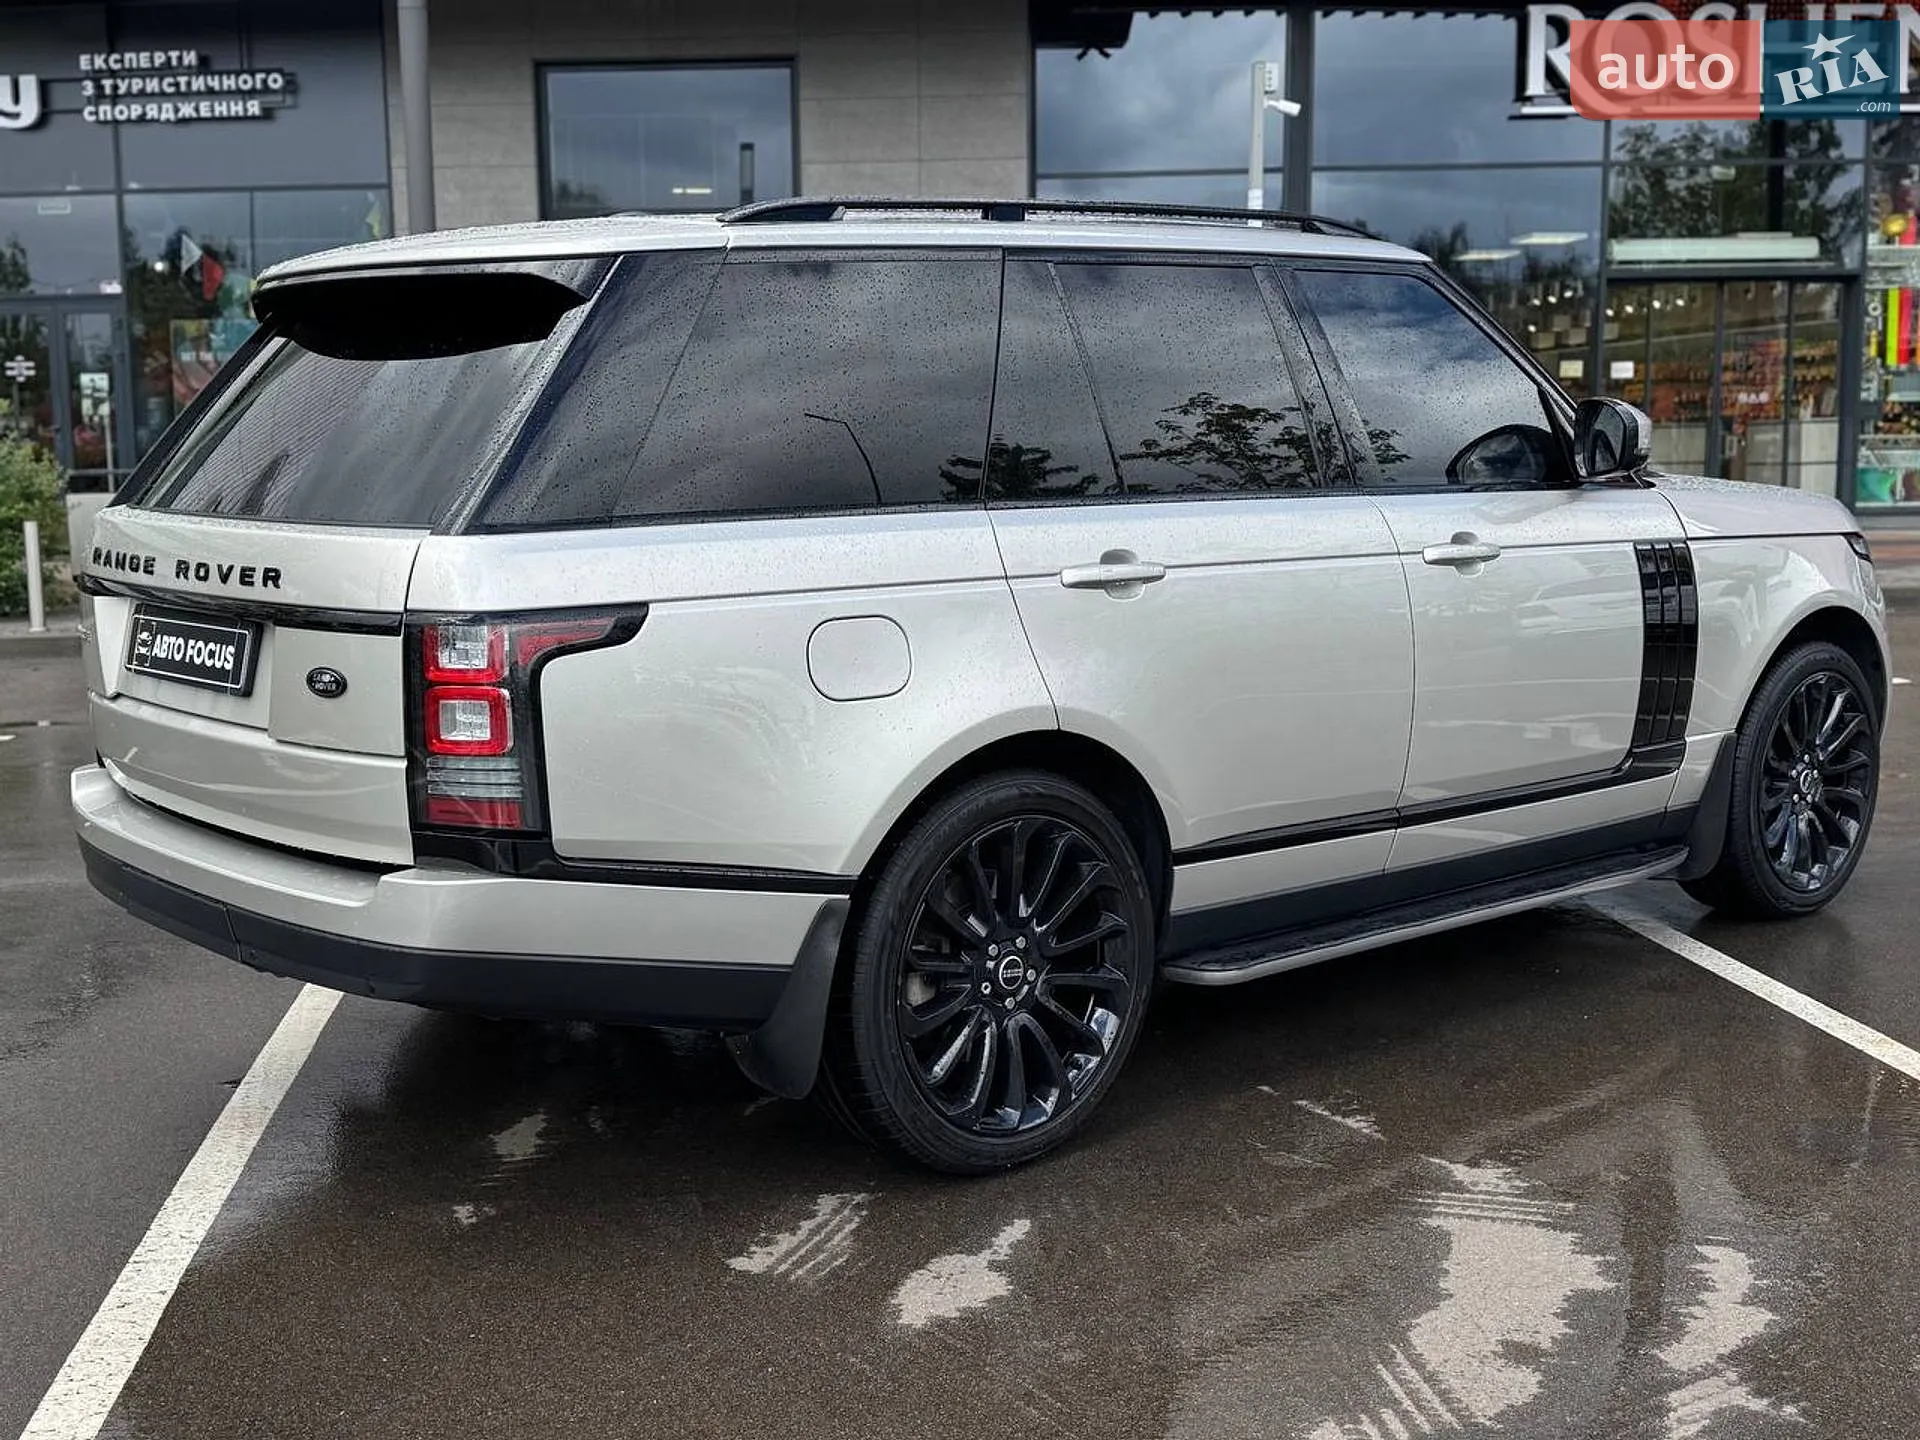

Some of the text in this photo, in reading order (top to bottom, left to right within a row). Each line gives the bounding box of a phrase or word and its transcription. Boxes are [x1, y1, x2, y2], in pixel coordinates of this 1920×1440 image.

[79, 51, 198, 70] ЕКСПЕРТИ
[101, 72, 284, 96] ТУРИСТИЧНОГО
[83, 100, 262, 122] СПОРЯДЖЕННЯ
[93, 547, 282, 589] RANGE ROVER
[185, 639, 235, 670] FOCUS
